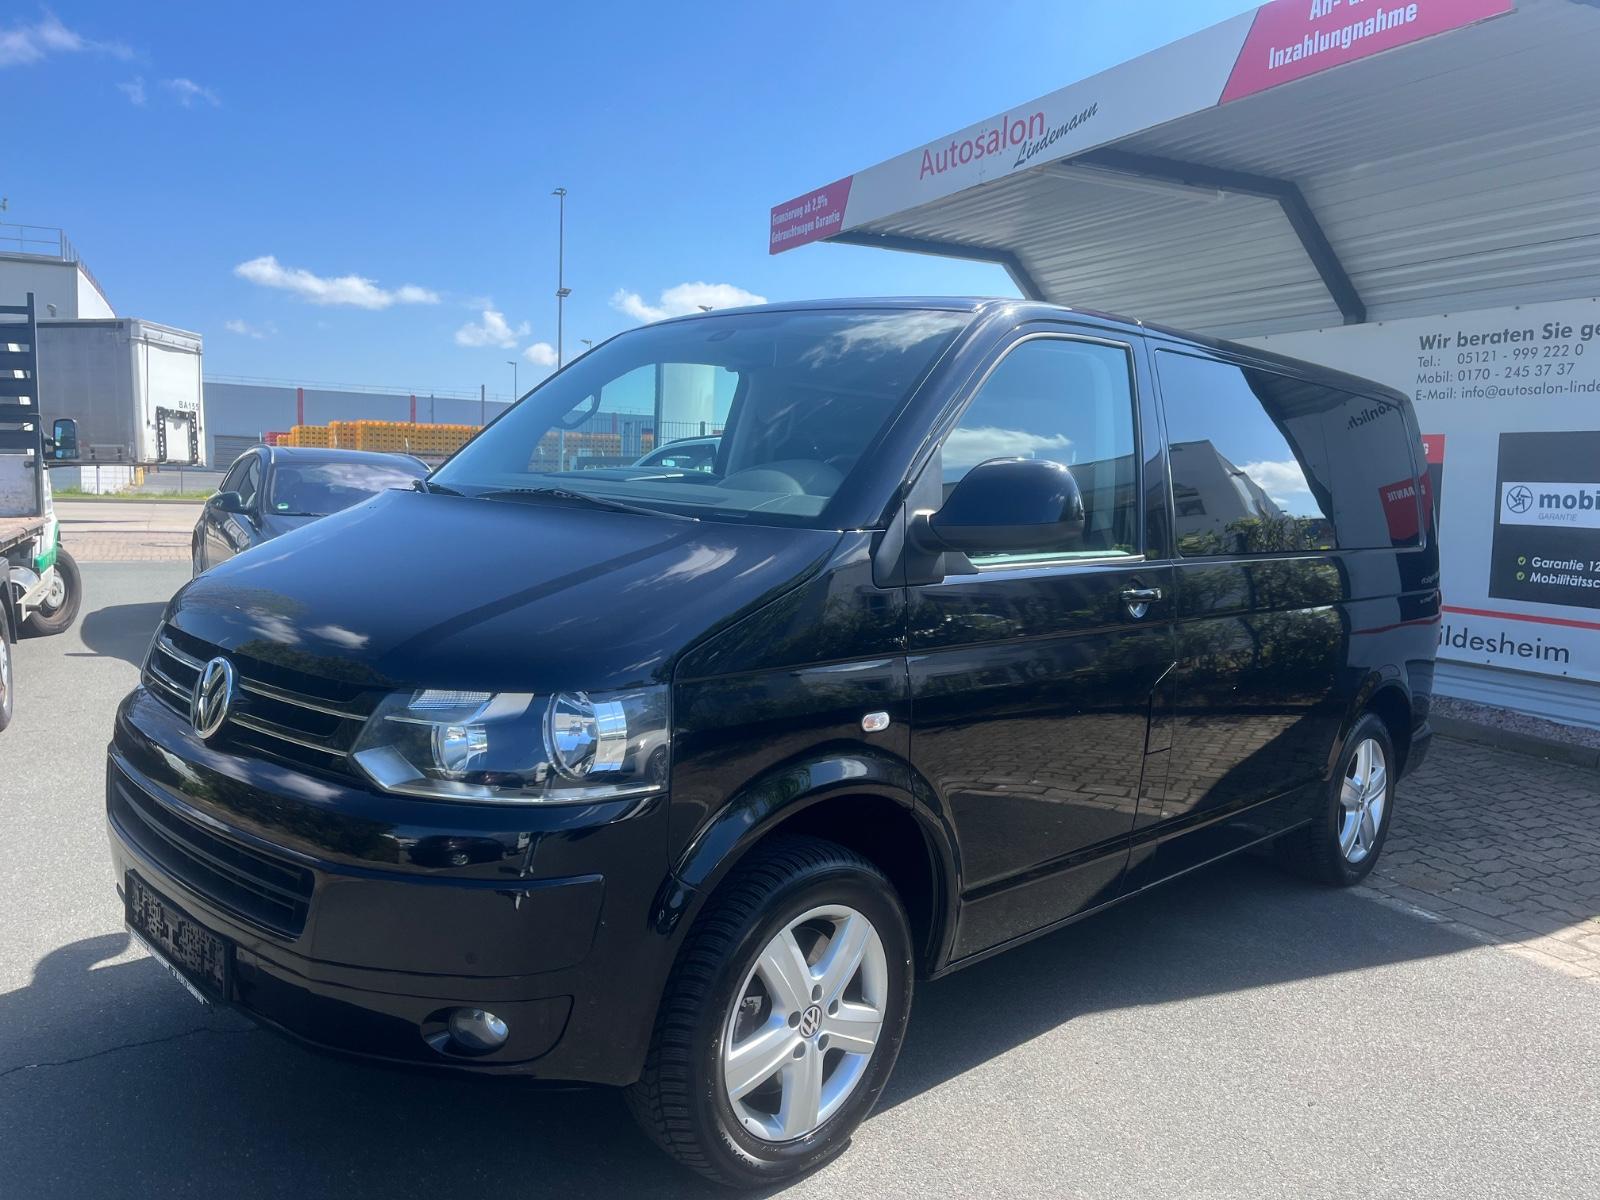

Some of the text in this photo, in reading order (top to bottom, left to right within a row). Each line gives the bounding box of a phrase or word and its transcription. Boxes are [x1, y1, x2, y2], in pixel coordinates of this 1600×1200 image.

[1268, 3, 1418, 70] Inzahlungnahme
[919, 111, 1045, 181] Autosalon
[1013, 102, 1098, 169] Lindemann
[1419, 333, 1451, 350] Wir
[1457, 328, 1534, 348] beraten
[1542, 322, 1573, 340] Sie
[1417, 356, 1441, 368] Tel.:
[1457, 350, 1497, 365] 05121
[1513, 347, 1538, 361] 999
[1543, 344, 1570, 358] 222
[1575, 343, 1584, 356] 0
[1416, 371, 1453, 385] Mobil:
[1457, 368, 1491, 382] 0170
[1504, 365, 1530, 379] 245
[1534, 363, 1552, 377] 37
[1556, 362, 1575, 376] 37
[1415, 388, 1457, 401] E-Mail:
[1538, 511, 1578, 522] GARANTIE
[1531, 556, 1584, 571] Garantie
